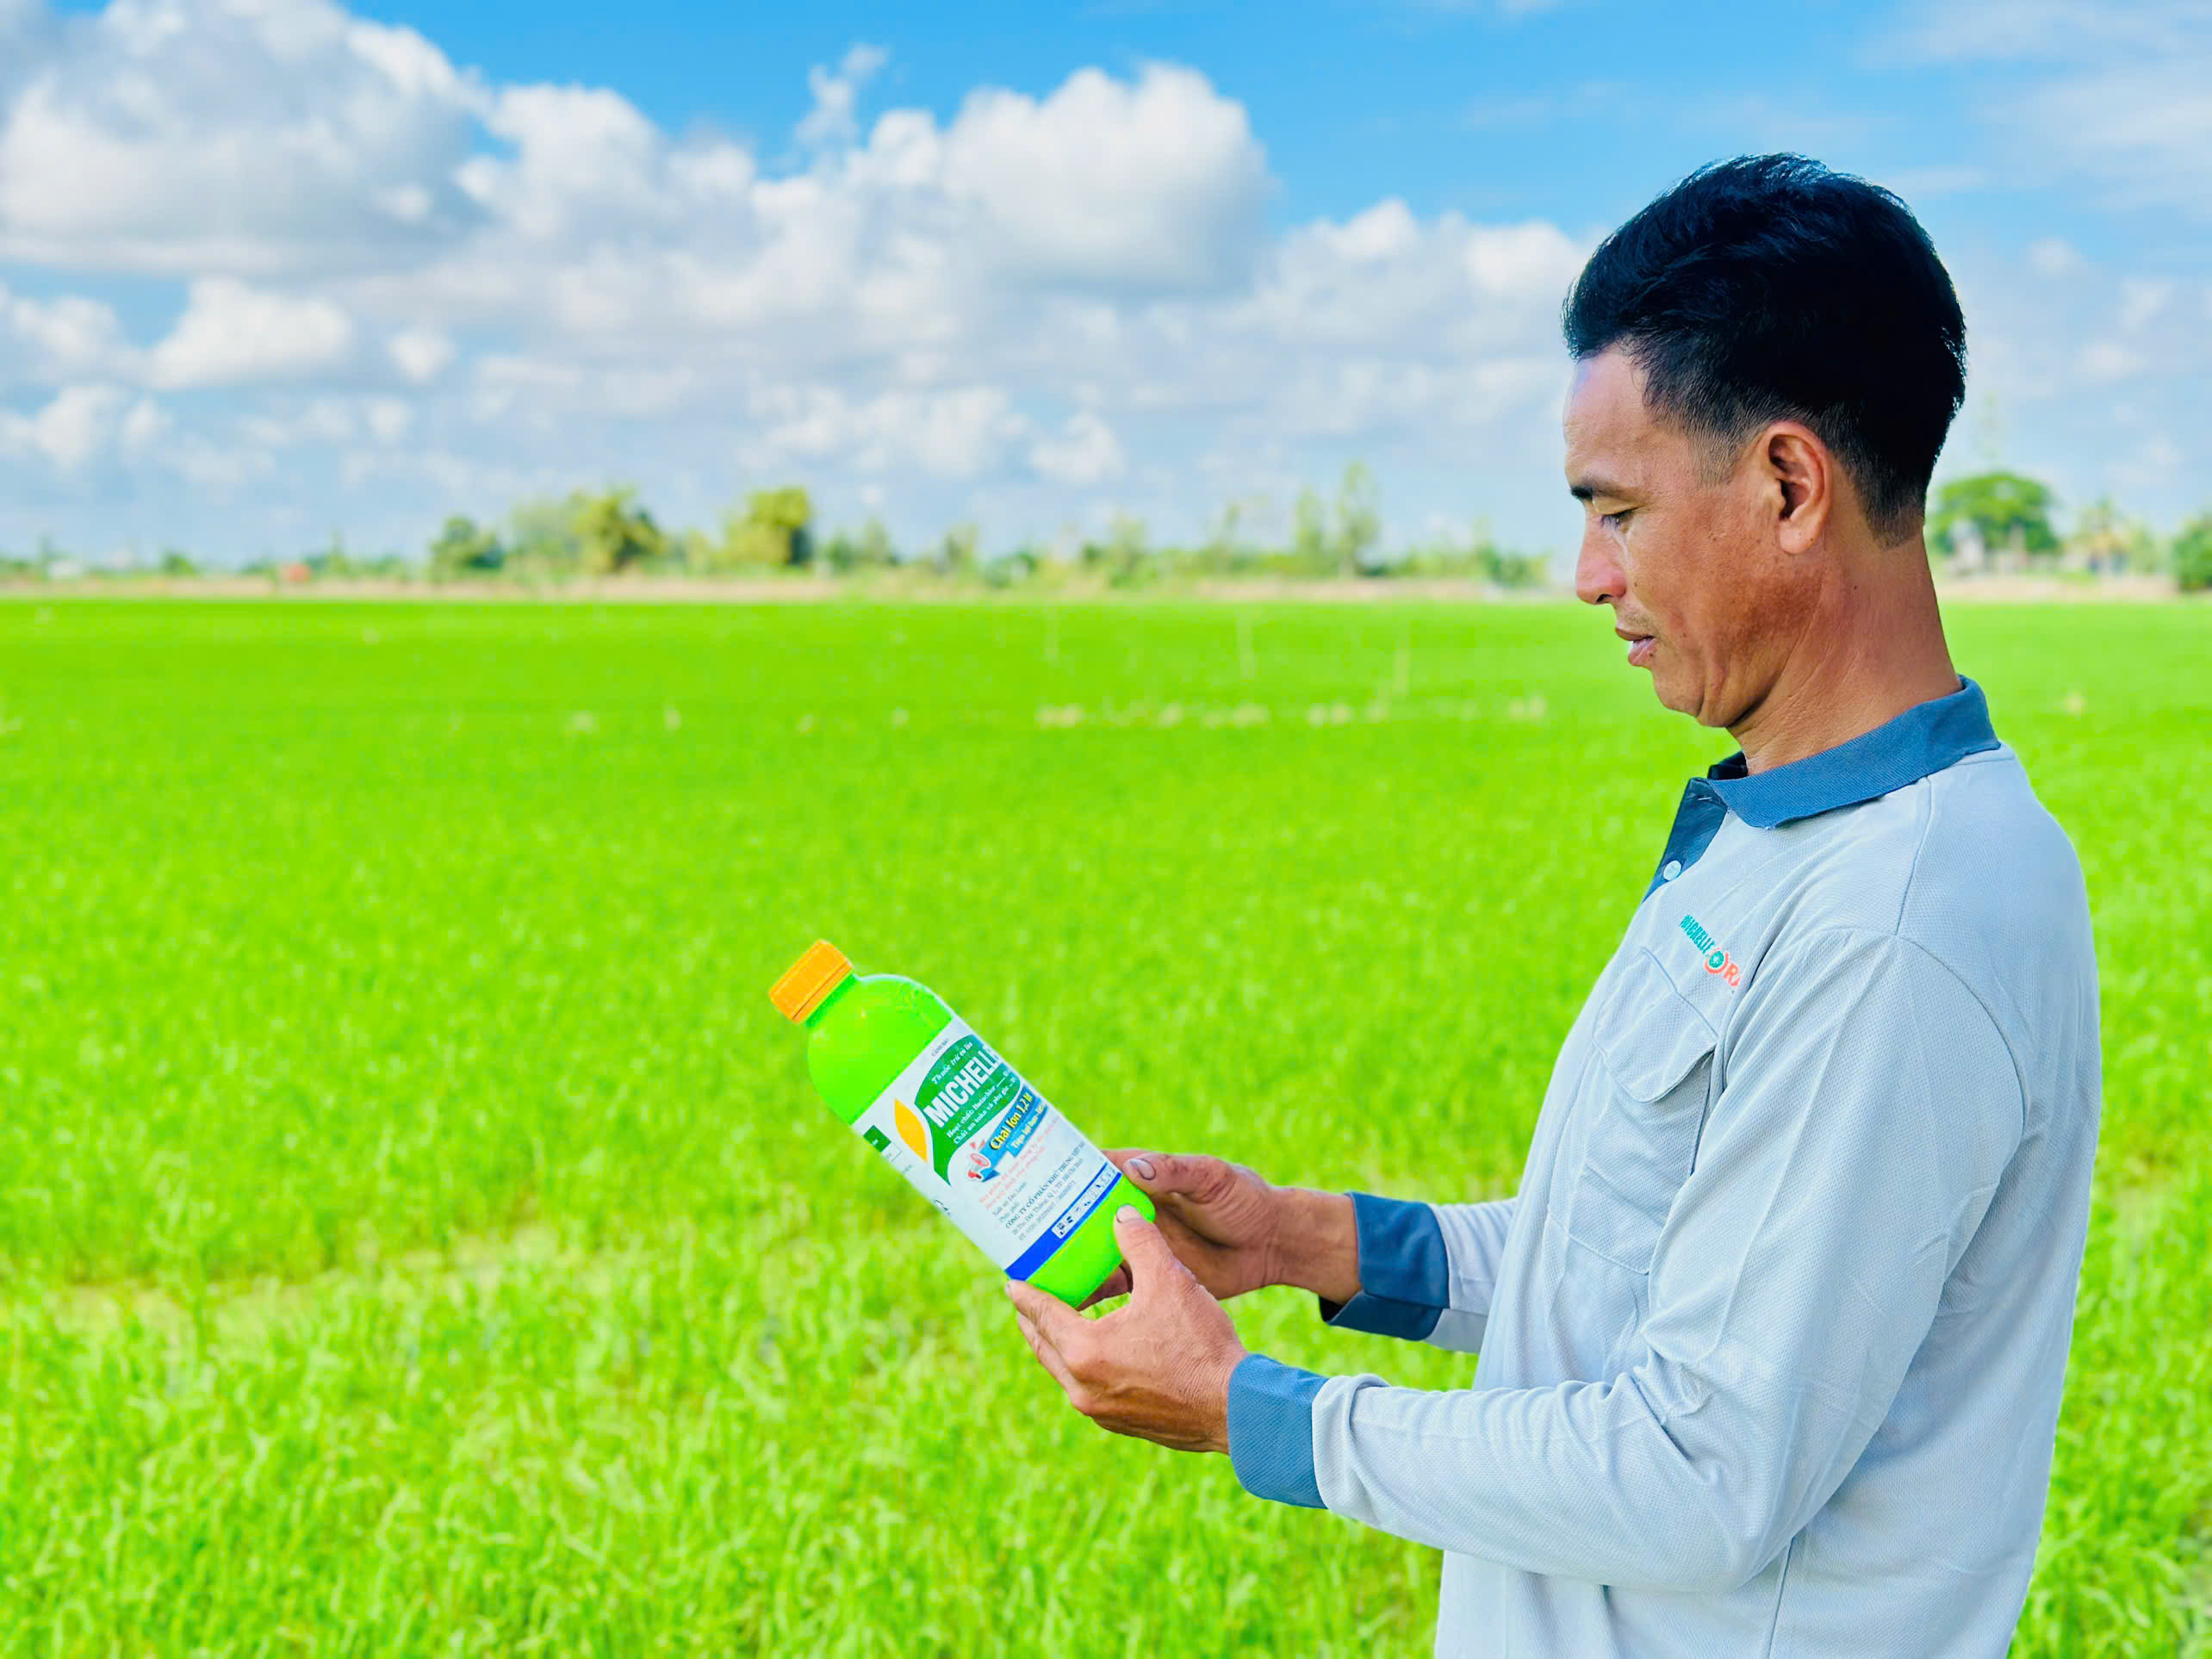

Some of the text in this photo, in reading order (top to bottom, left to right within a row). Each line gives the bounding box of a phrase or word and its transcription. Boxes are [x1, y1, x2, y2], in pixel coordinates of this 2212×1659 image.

[1679, 914, 1717, 957] MICHELLE
[931, 1063, 951, 1084] Thuốc
[989, 1125, 1010, 1151] Chai
